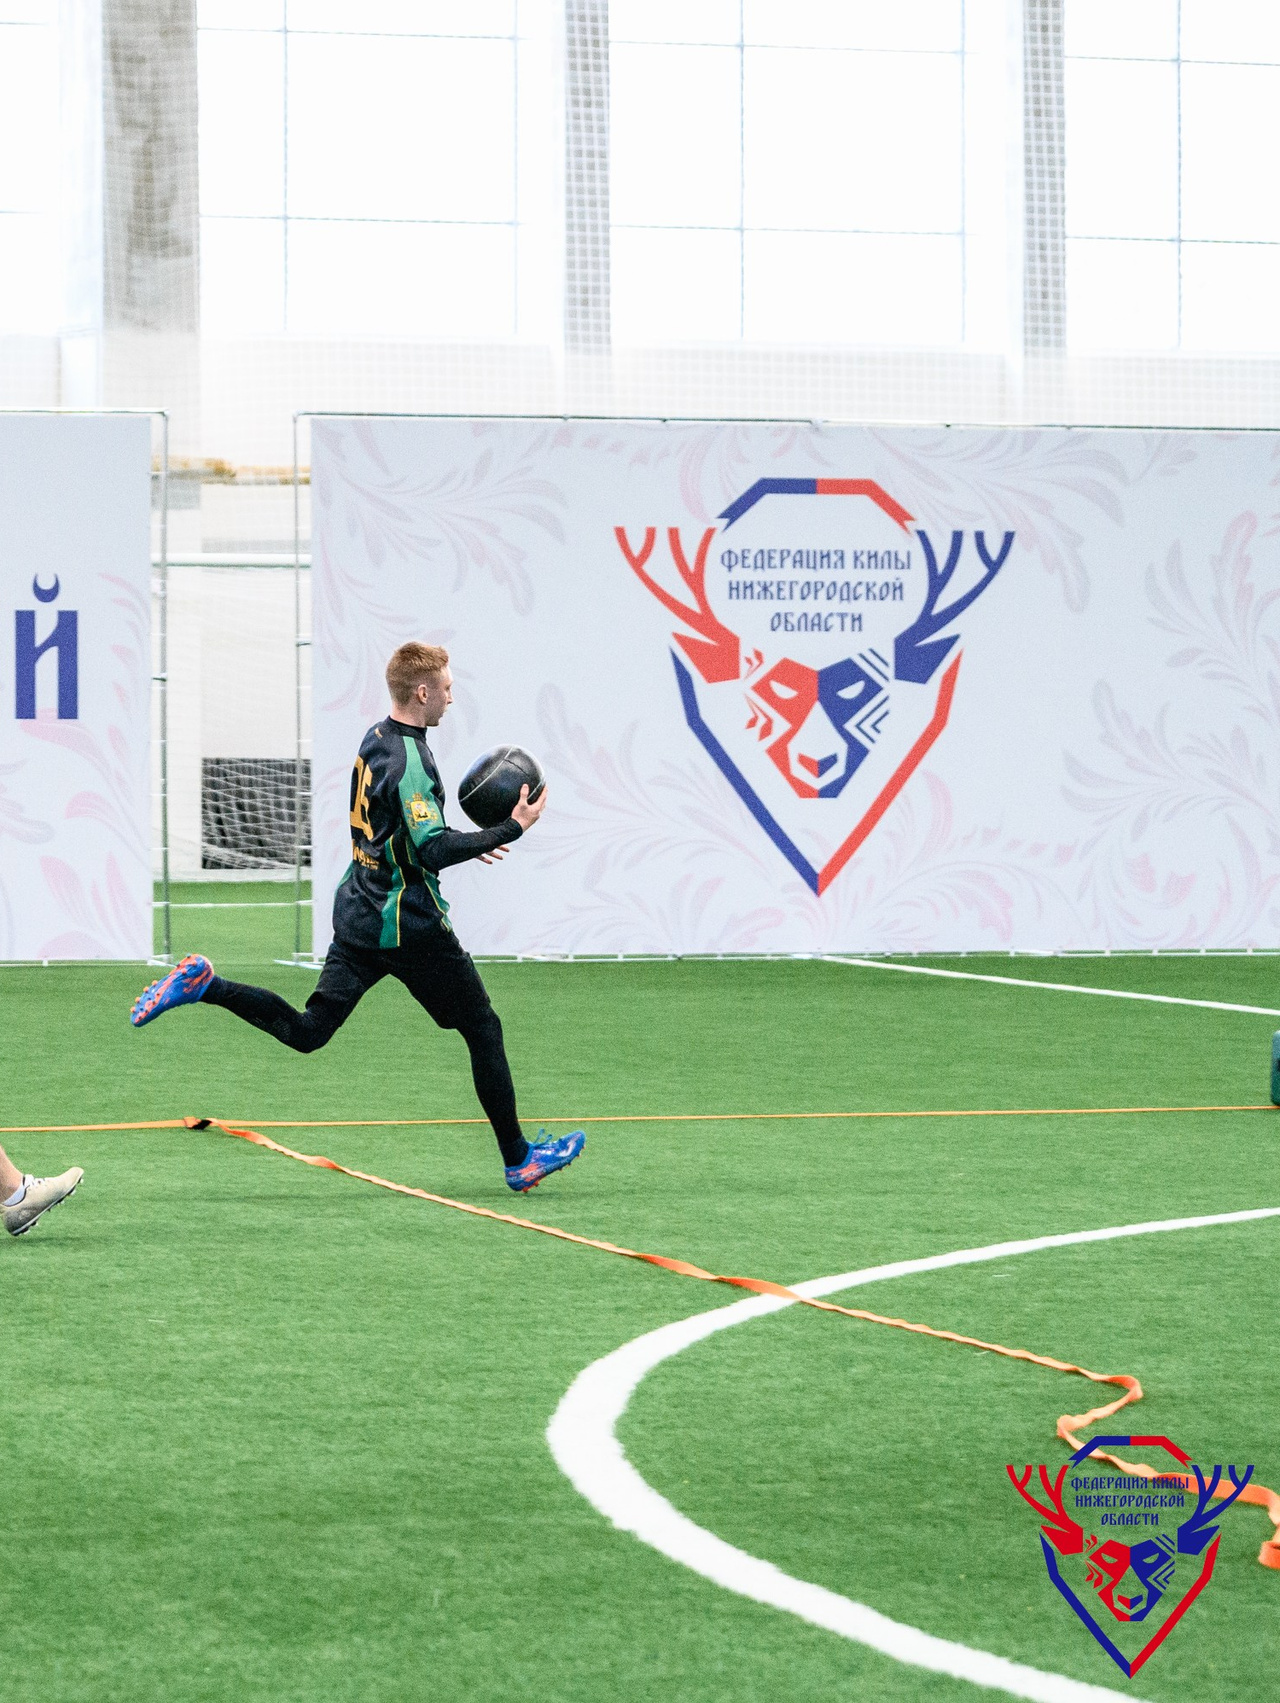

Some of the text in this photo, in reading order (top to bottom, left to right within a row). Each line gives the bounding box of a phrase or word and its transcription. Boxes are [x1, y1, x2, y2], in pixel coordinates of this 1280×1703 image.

[721, 549, 912, 573] ФЕДЕРАЦИЯ КИЛЫ
[728, 577, 905, 603] НИЖЕГОРОДСКОЙ
[770, 612, 864, 633] ОБЛАСТИ
